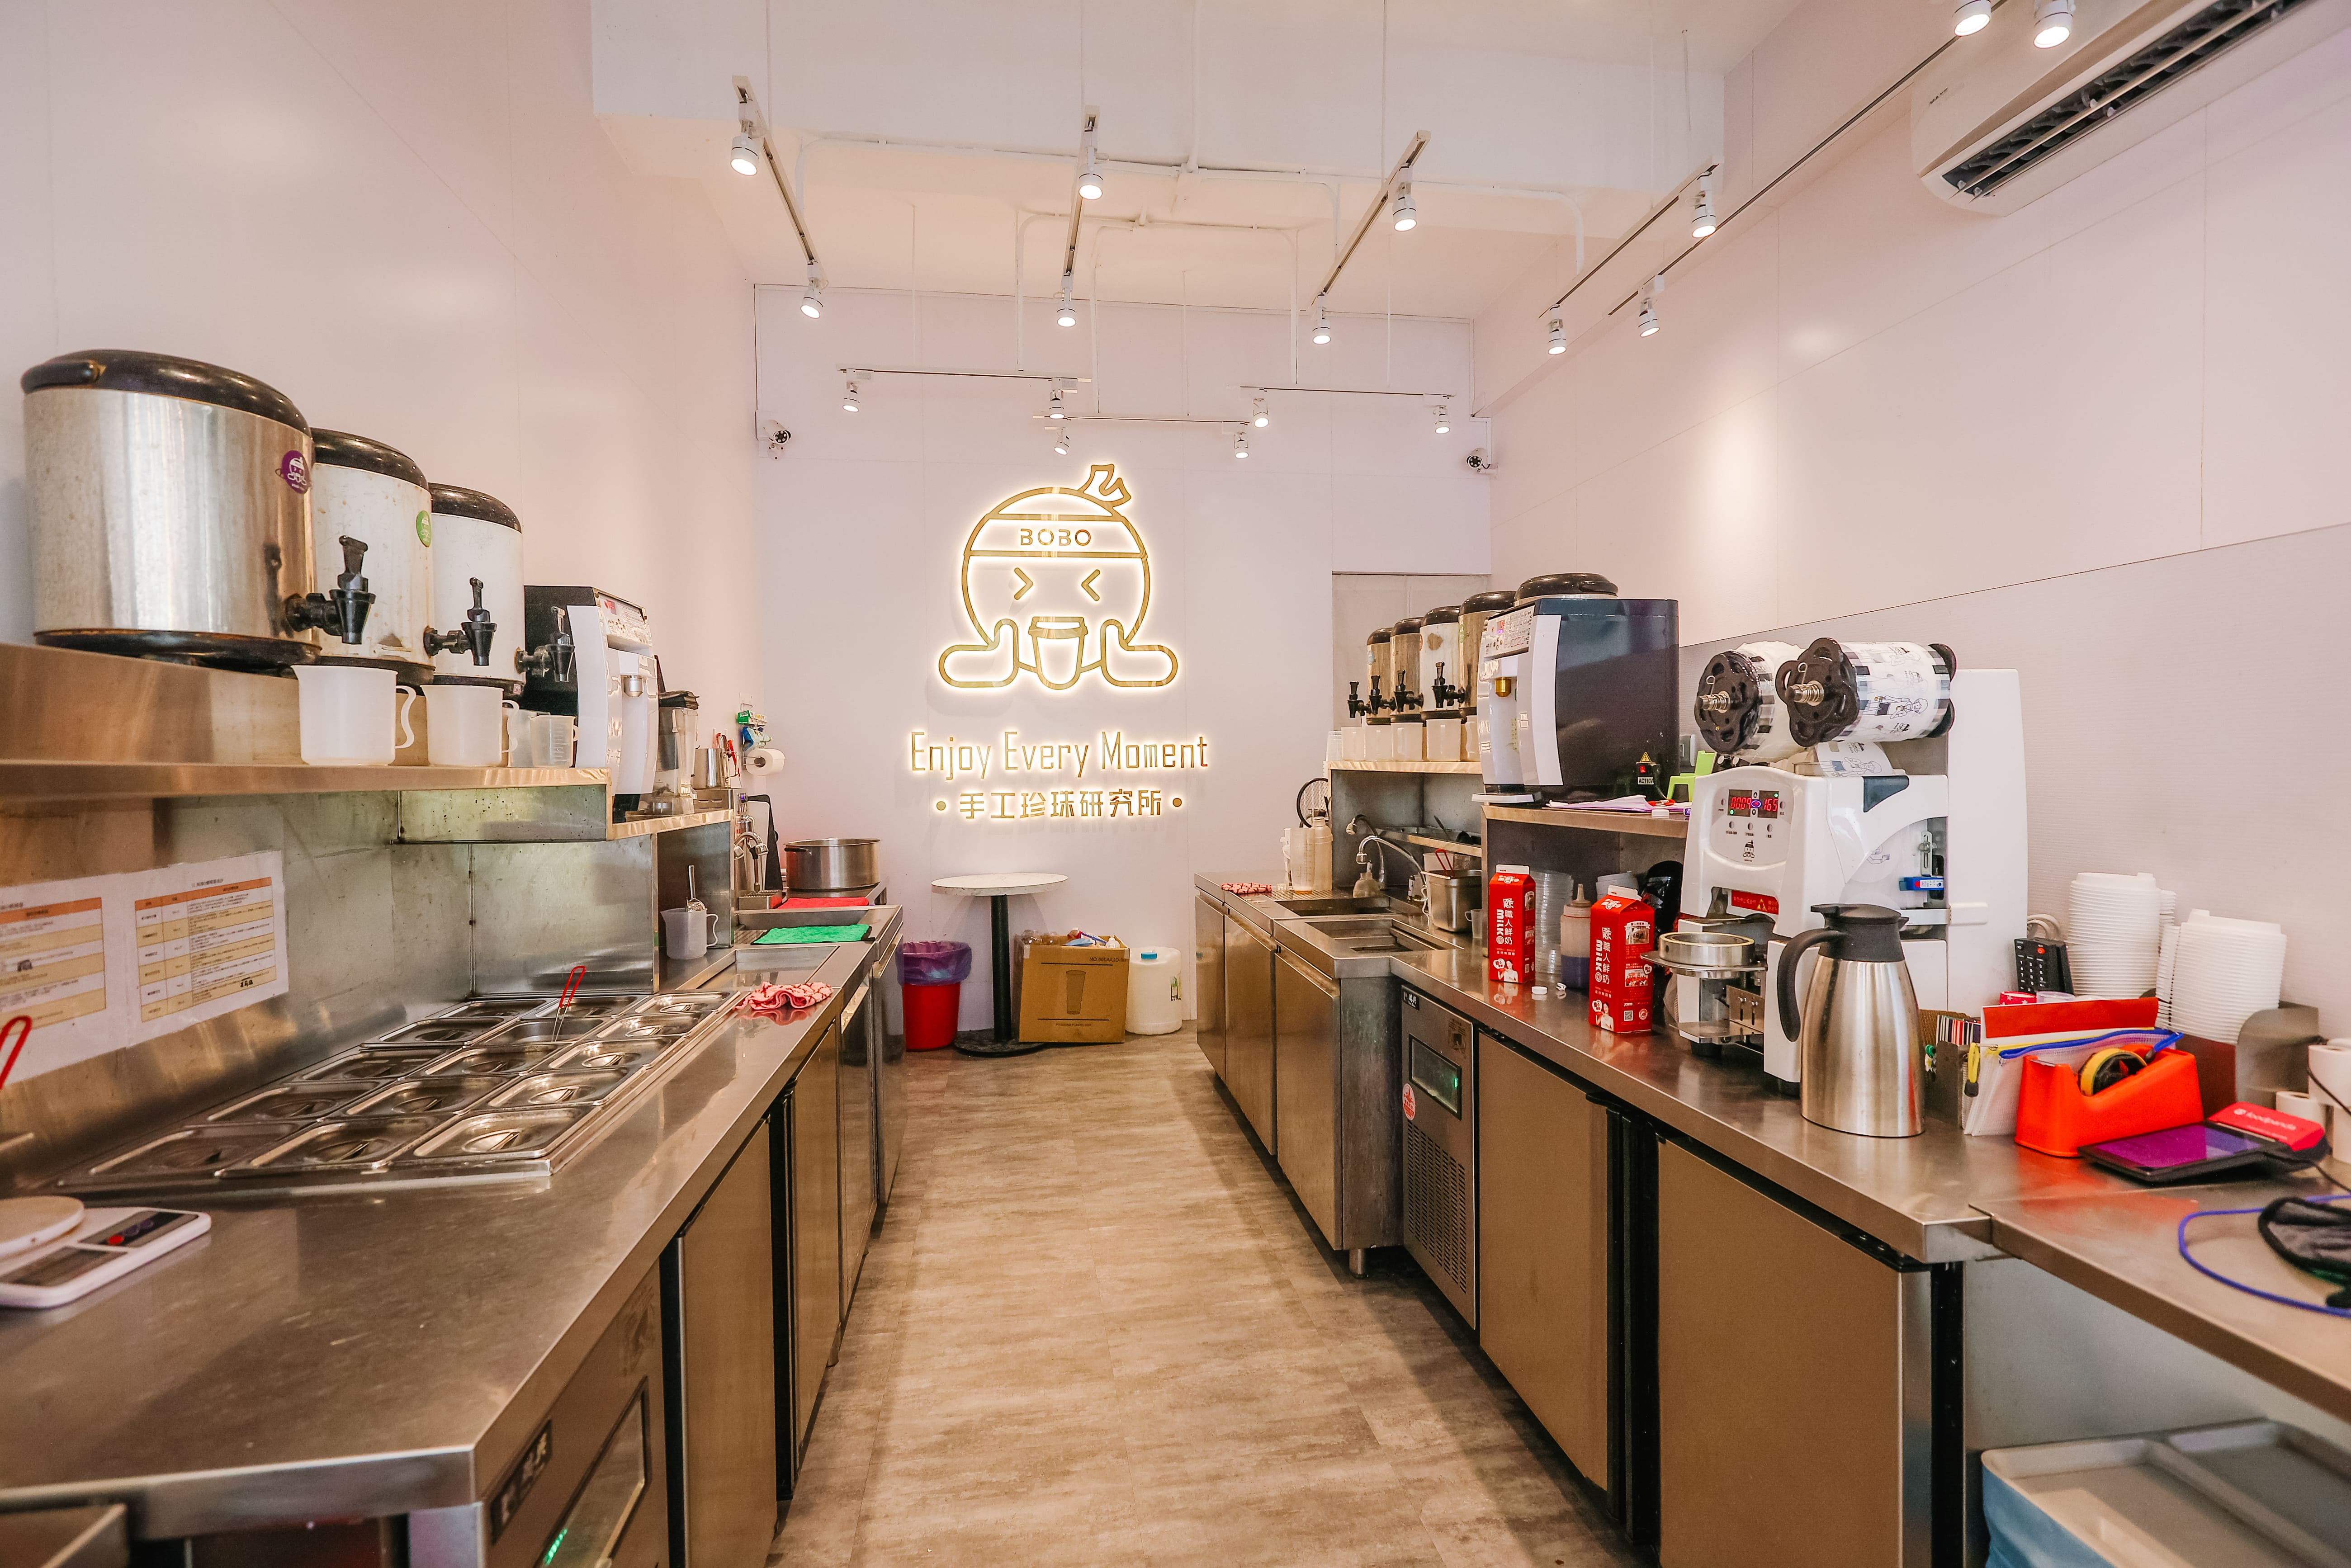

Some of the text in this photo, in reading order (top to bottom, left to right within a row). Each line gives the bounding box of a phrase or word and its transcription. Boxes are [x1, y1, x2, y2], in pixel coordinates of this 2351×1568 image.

[1020, 528, 1091, 546] BOBO
[911, 731, 1208, 780] Enjoy Every Moment
[960, 789, 1161, 819] 手工珍珠研究所
[1730, 797, 1752, 810] 0009
[1764, 798, 1779, 812] 165
